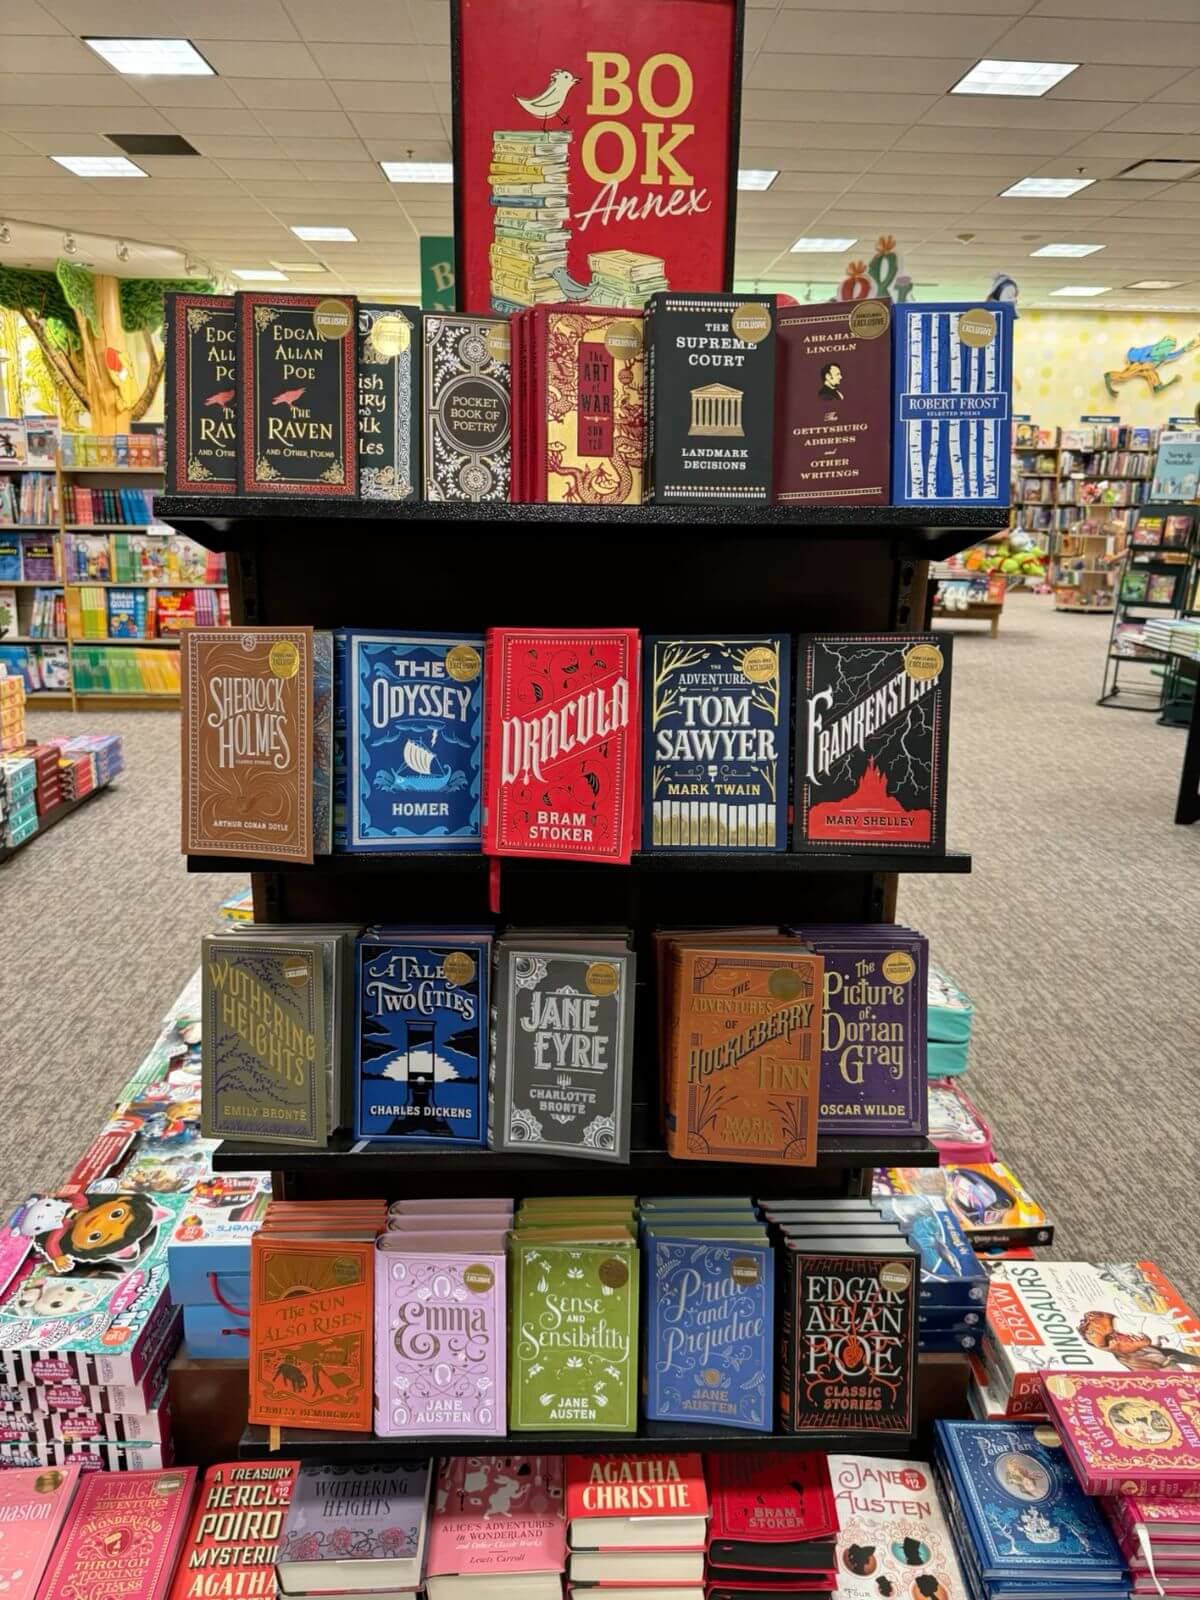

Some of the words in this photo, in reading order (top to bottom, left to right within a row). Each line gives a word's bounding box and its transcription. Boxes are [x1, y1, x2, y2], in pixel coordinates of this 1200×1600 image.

[586, 51, 694, 118] BO
[581, 121, 695, 186] OK
[574, 180, 712, 231] Annex
[705, 323, 729, 332] THE
[676, 337, 758, 350] SUPREME
[806, 343, 857, 354] LINCOLN
[275, 344, 323, 360] ALLAN
[689, 354, 745, 367] COURT
[283, 365, 316, 379] POE
[584, 364, 609, 383] ART
[452, 396, 498, 408] POCKET
[581, 394, 610, 413] WAR
[909, 398, 957, 409] ROBERT
[959, 397, 999, 409] FROST
[290, 407, 311, 419] THE
[451, 409, 483, 420] BOOK
[485, 411, 500, 420] OF
[268, 417, 333, 447] RAVEN
[454, 421, 498, 433] POETRY
[793, 423, 868, 435] GETTYSBURG
[804, 436, 856, 446] ADDRESS
[681, 449, 748, 458] LANDMARK
[684, 460, 747, 470] DECISIONS
[810, 458, 849, 468] OTHER
[801, 469, 860, 480] WRITINGS
[395, 660, 445, 678] THE
[207, 676, 286, 728] SHERLOCK
[372, 678, 472, 729] ODYSSEY
[679, 696, 752, 726] TOM
[501, 676, 629, 785] DRACULA
[219, 712, 290, 769] HOLMES
[656, 728, 778, 761] SAWYER
[668, 784, 709, 795] MARK
[715, 784, 760, 796] TWAIN
[392, 803, 449, 816] HOMER
[213, 820, 242, 828] ARTHUR
[538, 811, 586, 826] BRAM
[826, 815, 858, 825] MARY
[863, 815, 915, 826] SHELLEY
[528, 827, 593, 842] STOKER
[369, 965, 395, 978] A
[390, 955, 446, 982] TALE
[855, 959, 876, 978] The
[730, 980, 750, 997] THE
[822, 971, 904, 1010] Picture
[366, 981, 416, 1016] TWO
[417, 981, 475, 1021] CITIES
[688, 999, 773, 1015] ADVENTURES
[209, 959, 315, 1061] WUTHERING
[520, 992, 600, 1033] JANE
[859, 1006, 872, 1021] of
[725, 1020, 738, 1029] OF
[822, 1012, 904, 1052] Dorian
[223, 992, 304, 1086] HEIGHTS
[688, 1003, 815, 1085] HUCKLEBERRY
[533, 1032, 609, 1071] EYRE
[838, 1044, 904, 1084] Gray
[758, 1055, 811, 1090] FINN
[529, 1089, 596, 1104] CHARLOTTE
[224, 1105, 258, 1116] EMILY
[370, 1105, 420, 1116] CHARLES
[423, 1106, 472, 1118] DICKENS
[820, 1104, 861, 1115] OSCAR
[864, 1104, 905, 1116] WILDE
[276, 1305, 304, 1322] The
[308, 1296, 345, 1316] SUN
[539, 1294, 605, 1330] Sense
[697, 1302, 730, 1326] and
[999, 1287, 1039, 1341] DRAW
[1011, 1267, 1095, 1366] DINOSAURS
[566, 1315, 586, 1323] AND
[805, 1305, 904, 1334] ALLAN
[260, 1323, 308, 1344] ALSO
[312, 1311, 363, 1335] RISES
[394, 1301, 489, 1362] Emma
[518, 1319, 630, 1364] Sensibility
[657, 1311, 765, 1373] Prejudice
[805, 1334, 902, 1376] POE
[692, 1390, 729, 1401] JANE
[825, 1386, 881, 1398] CLASSIC
[426, 1400, 464, 1411] JANE
[558, 1397, 589, 1408] JANE
[682, 1400, 737, 1414] AUSTEN
[823, 1399, 882, 1410] STORIES
[416, 1411, 471, 1423] AUSTEN
[550, 1409, 596, 1420] AUSTEN
[972, 1434, 1009, 1467] Peter
[1001, 1431, 1032, 1453] Pan
[214, 1471, 222, 1482] A
[229, 1468, 292, 1480] TREASURY
[589, 1460, 681, 1484] AGATHA
[838, 1462, 901, 1498] JANE
[315, 1479, 409, 1498] WUTHERING
[582, 1484, 691, 1510] CHRISTIE
[836, 1490, 931, 1519] AUSTEN
[323, 1499, 391, 1517] HEIGHTS
[753, 1507, 797, 1518] BRAM
[442, 1521, 482, 1533] ALICE'S
[485, 1520, 555, 1531] ADVENTURES
[749, 1517, 805, 1529] STOKER
[470, 1530, 543, 1540] WONDERLAND
[75, 1558, 150, 1571] THROUGH
[470, 1555, 494, 1564] Lewis
[496, 1553, 525, 1564] Carroll
[187, 1571, 278, 1598] AGATHA
